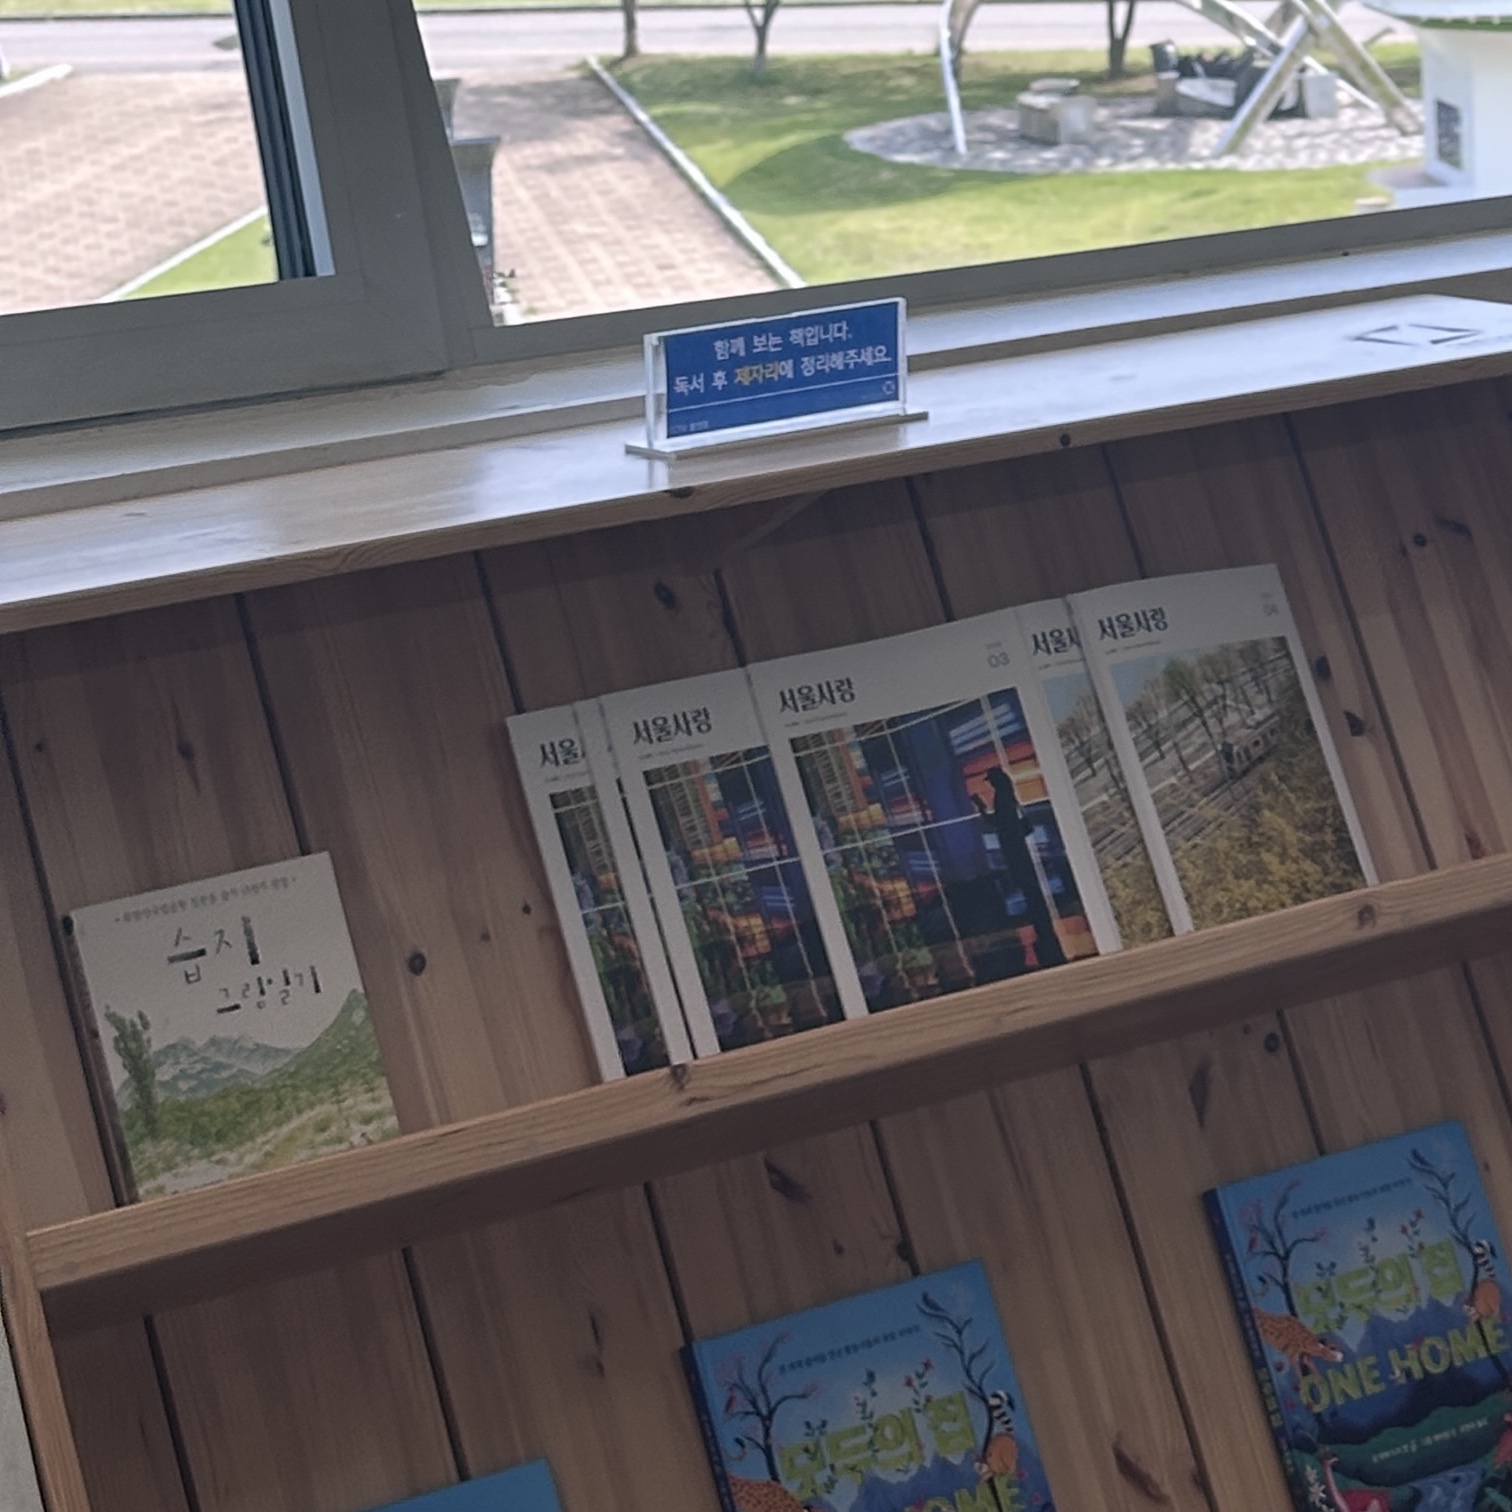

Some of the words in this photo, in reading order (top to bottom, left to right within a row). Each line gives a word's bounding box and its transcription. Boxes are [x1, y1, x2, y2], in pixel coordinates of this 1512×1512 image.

[713, 336, 746, 361] 함께
[752, 331, 783, 354] 보는
[789, 320, 853, 348] 책입니다.
[673, 372, 705, 396] 독서
[711, 370, 728, 391] 후
[734, 358, 794, 386] 제자리에
[1098, 606, 1169, 641] 서울사랑
[986, 651, 1010, 669] 03
[779, 677, 856, 714] 서울사랑
[632, 707, 712, 745] 서울사랑
[539, 738, 586, 768] 서울
[1301, 1355, 1386, 1413] ONE
[1389, 1318, 1511, 1384] HOME
